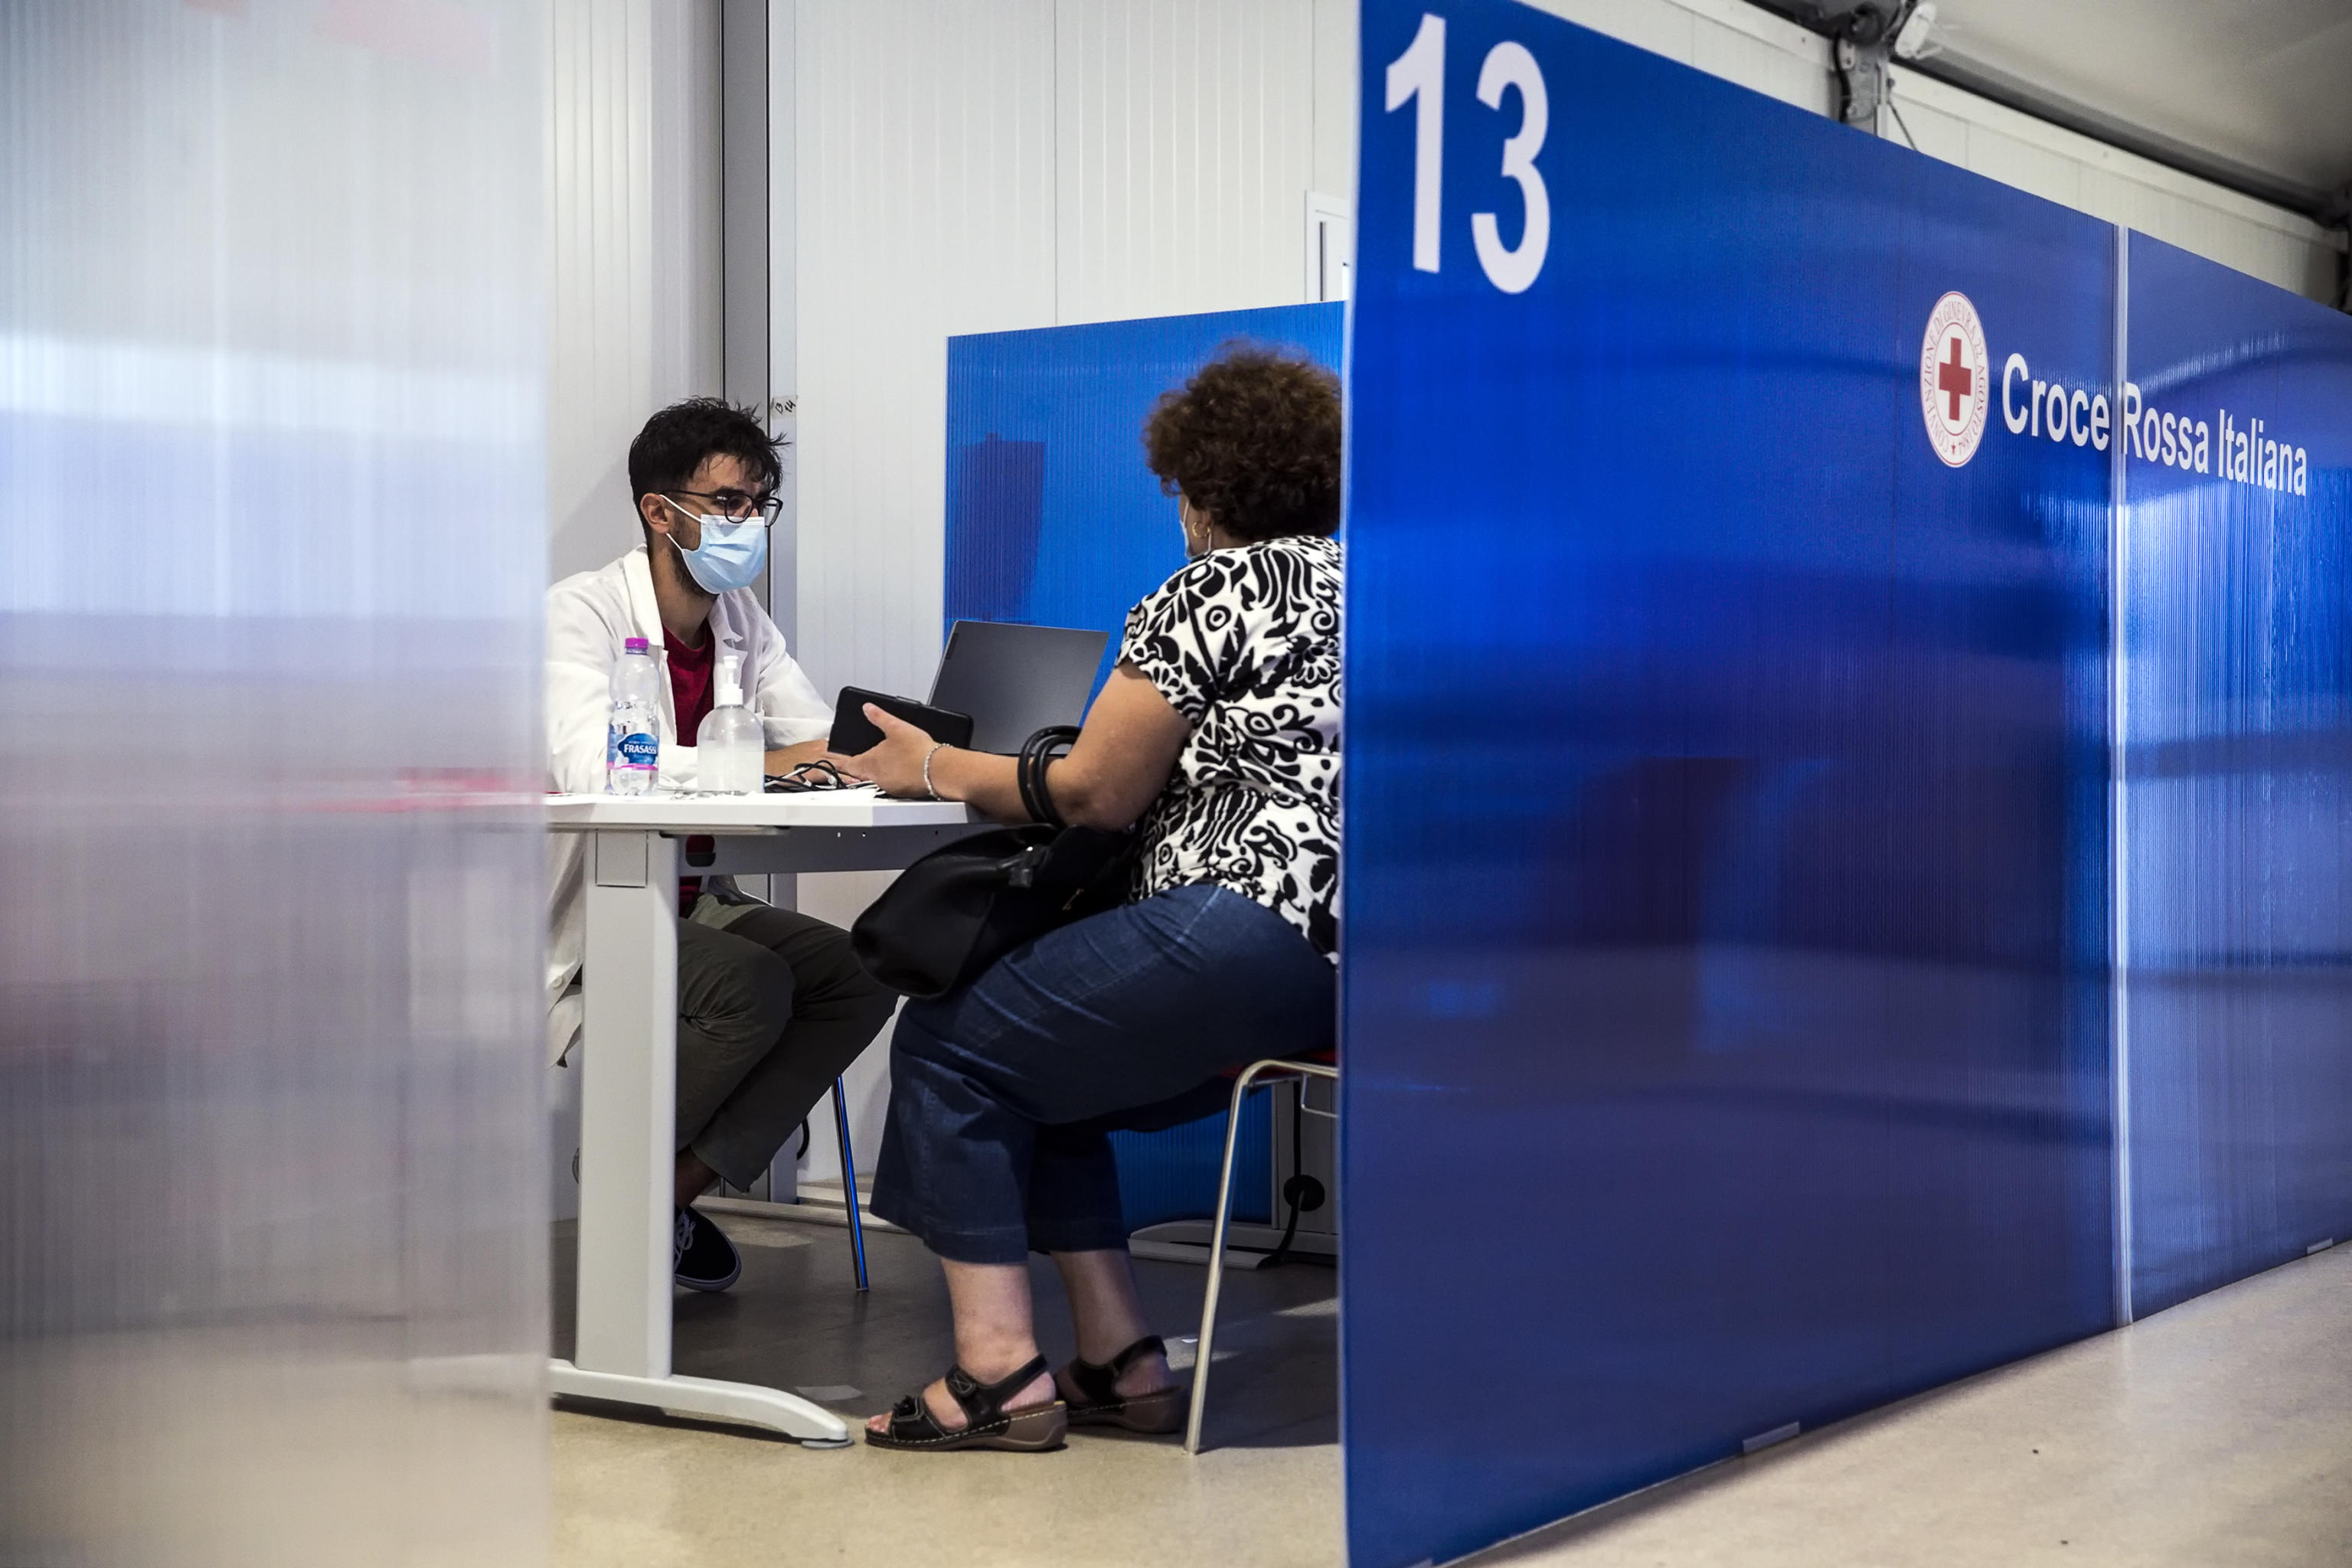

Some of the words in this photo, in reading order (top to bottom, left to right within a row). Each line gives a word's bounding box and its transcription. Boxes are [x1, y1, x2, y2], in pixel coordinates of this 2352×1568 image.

[1385, 11, 1550, 294] 13
[1933, 310, 1945, 335] DI
[1974, 338, 1984, 360] 22
[2002, 352, 2110, 451] Croce
[2123, 381, 2209, 475] Rossa
[2217, 408, 2307, 497] Italiana
